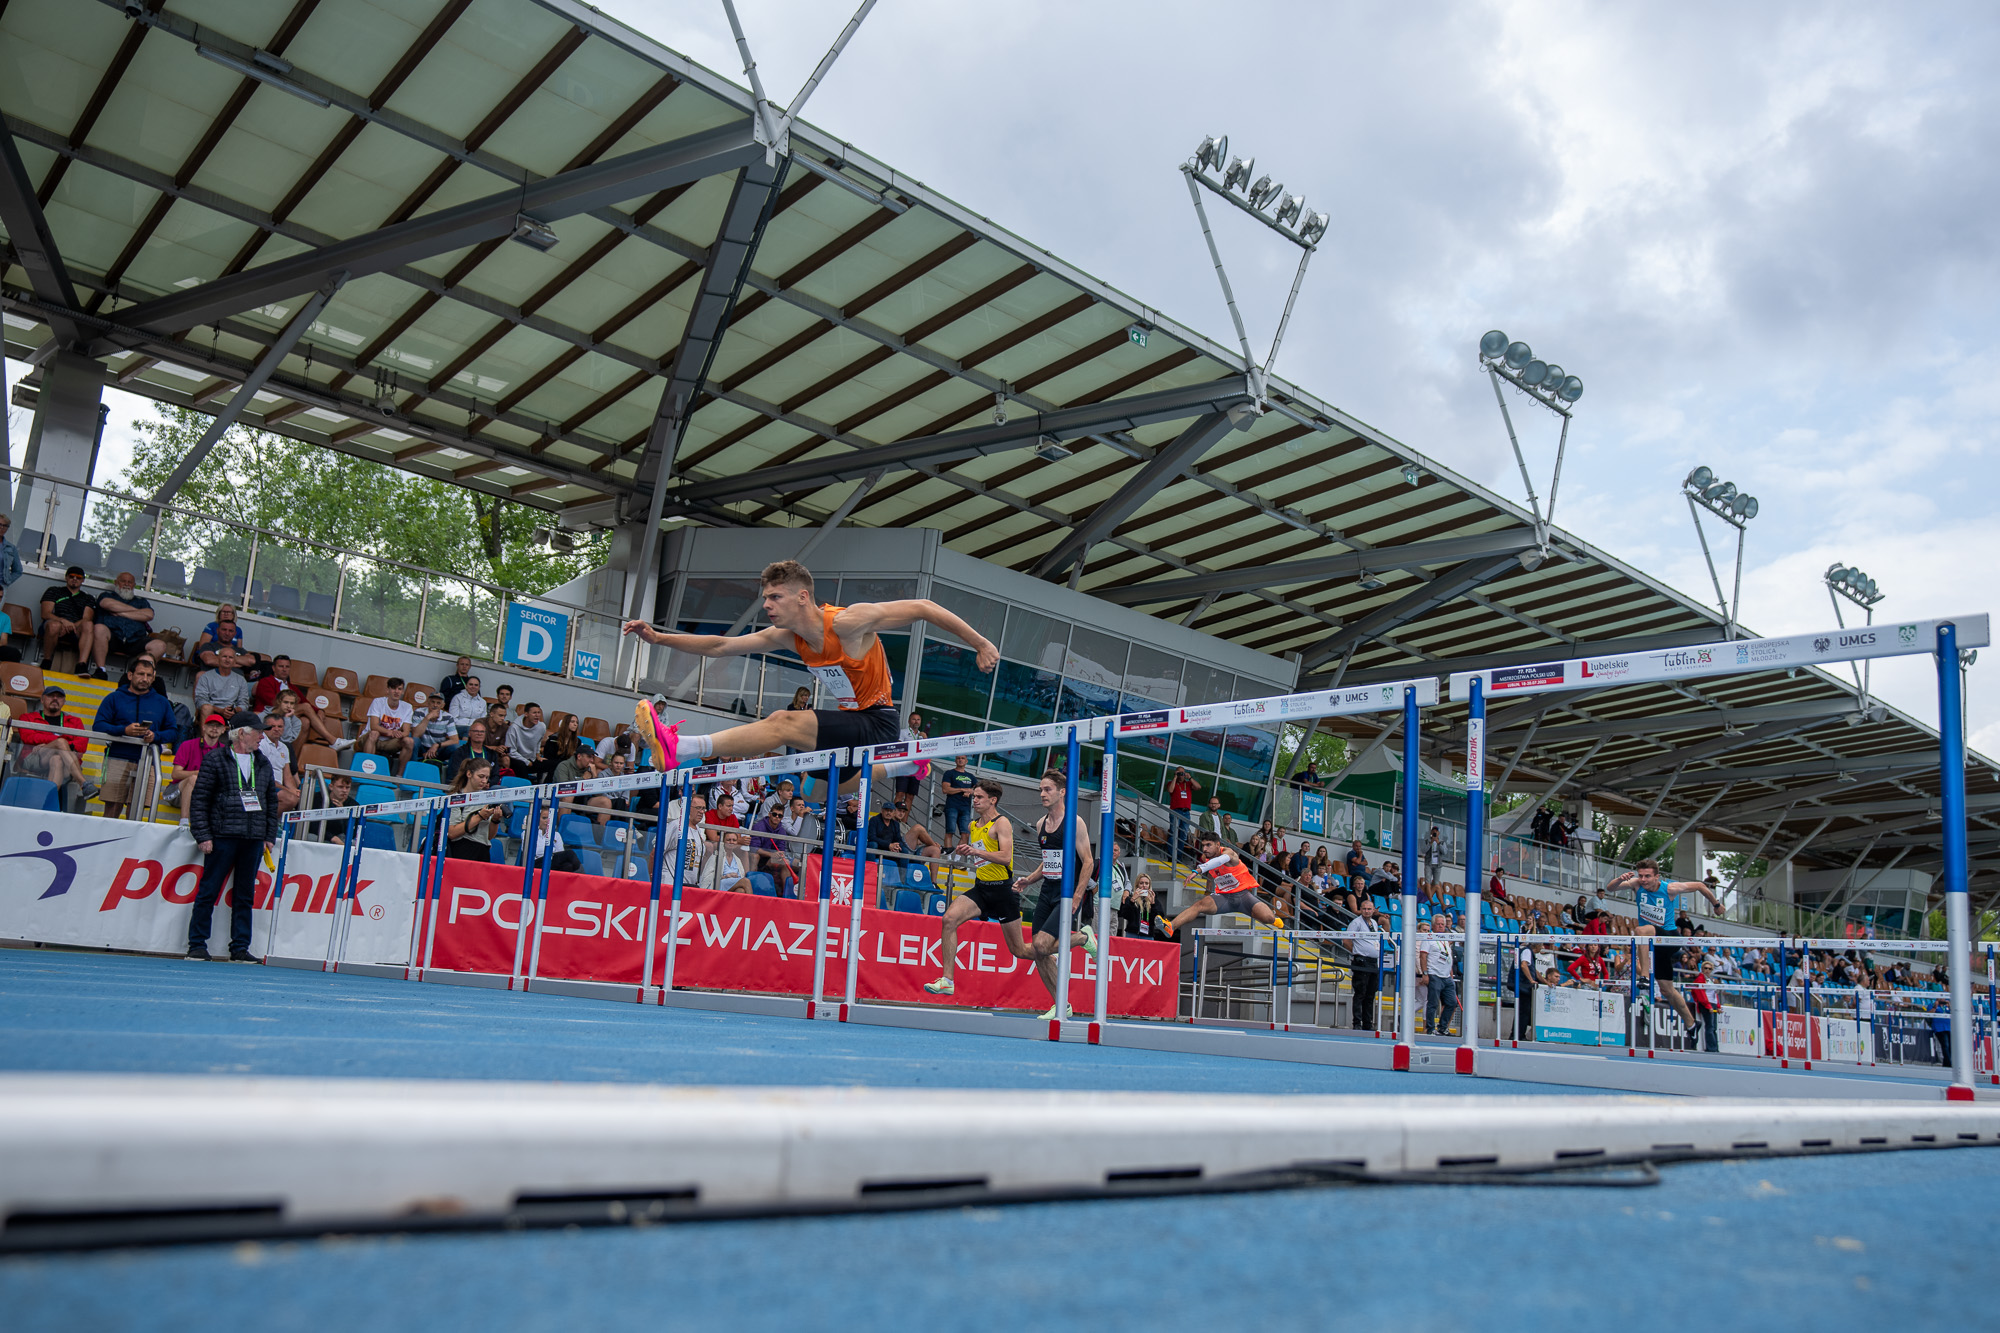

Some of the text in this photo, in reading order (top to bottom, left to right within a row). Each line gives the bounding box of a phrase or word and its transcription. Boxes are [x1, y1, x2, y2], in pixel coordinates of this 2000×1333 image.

[520, 609, 557, 626] SEKTOR
[517, 621, 553, 663] D
[1839, 632, 1876, 647] UMCS
[577, 653, 599, 670] WC
[1590, 659, 1629, 671] lubelskie
[823, 668, 842, 678] 701
[1345, 692, 1369, 703] UMCS
[1186, 709, 1212, 718] lubelskie
[1029, 729, 1047, 738] UMCS
[1469, 736, 1478, 777] polanik
[1304, 794, 1322, 804] SEKTORY
[1302, 805, 1323, 825] E-H
[1382, 832, 1392, 841] WC
[1640, 892, 1648, 904] 5
[448, 886, 647, 942] POLSKI
